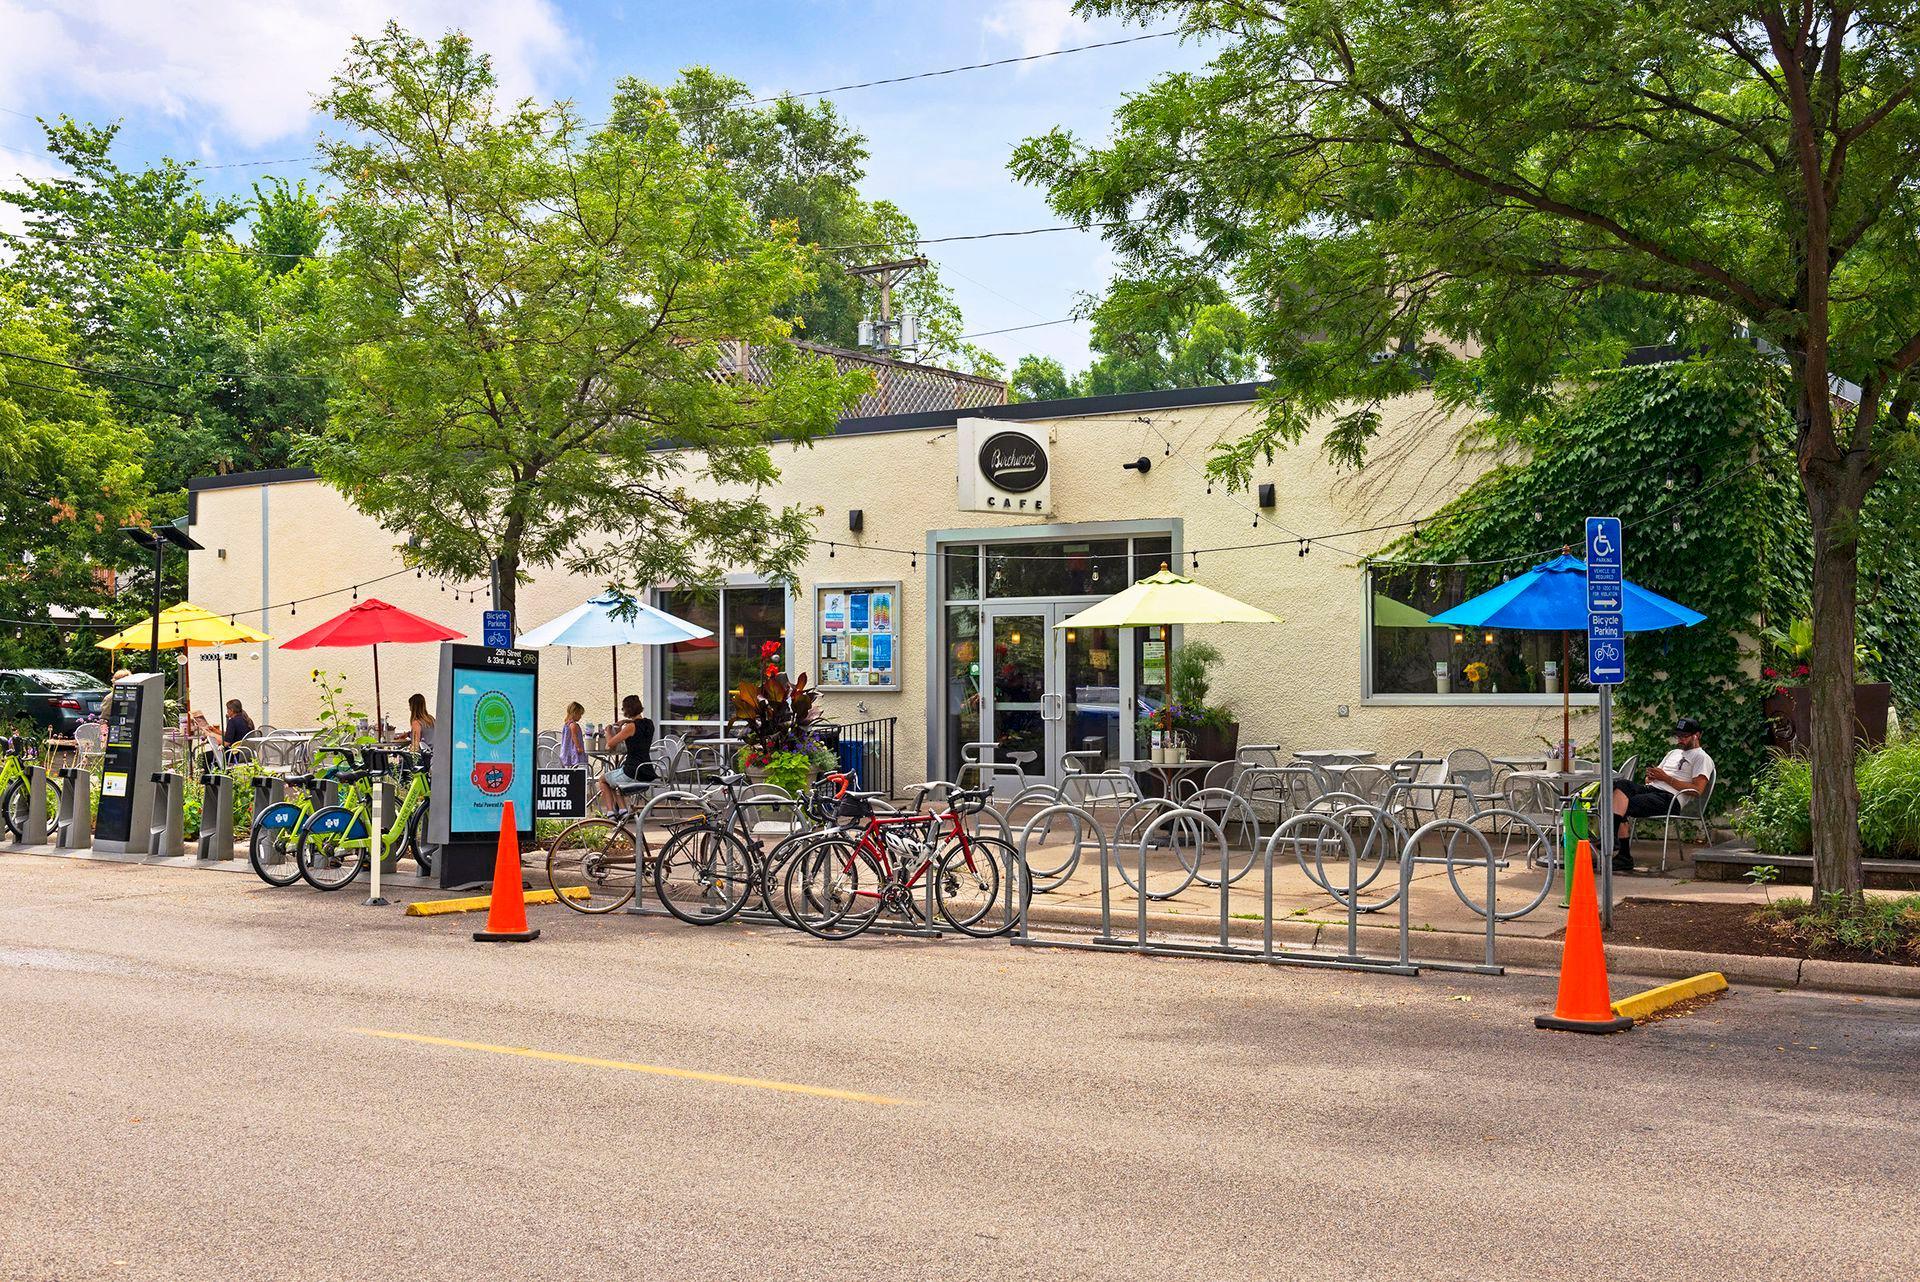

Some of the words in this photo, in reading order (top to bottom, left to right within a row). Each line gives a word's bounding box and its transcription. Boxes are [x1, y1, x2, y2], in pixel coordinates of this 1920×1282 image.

[991, 448, 1036, 469] Birchwood
[987, 496, 1043, 510] CAFE
[486, 612, 507, 622] Bicycle
[1592, 615, 1619, 627] Bicycle
[487, 620, 507, 629] Parking
[1594, 626, 1618, 638] Parking
[495, 648, 507, 656] 25th
[507, 649, 522, 658] Street
[487, 656, 492, 664] &
[506, 658, 516, 666] Ave.
[517, 658, 522, 666] S
[540, 774, 570, 785] BLACK
[542, 787, 567, 798] LIVES
[537, 799, 572, 810] MATTER
